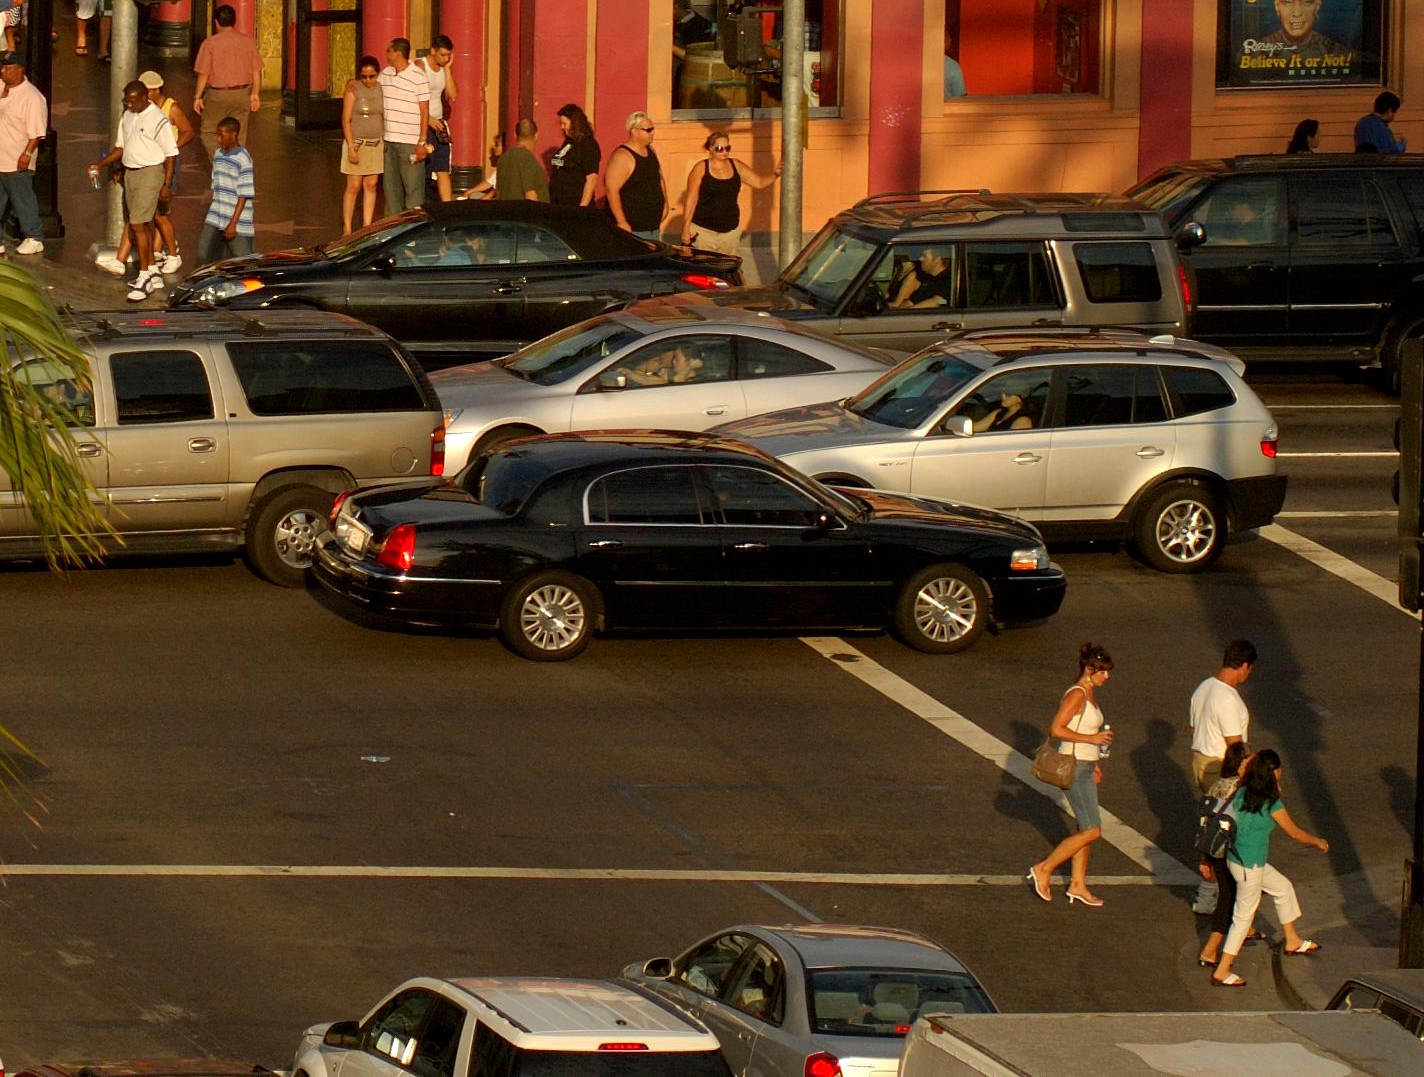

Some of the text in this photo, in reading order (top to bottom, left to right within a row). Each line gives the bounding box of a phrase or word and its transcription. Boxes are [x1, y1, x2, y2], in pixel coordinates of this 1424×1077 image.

[1240, 52, 1353, 68] Believe It or Not!
